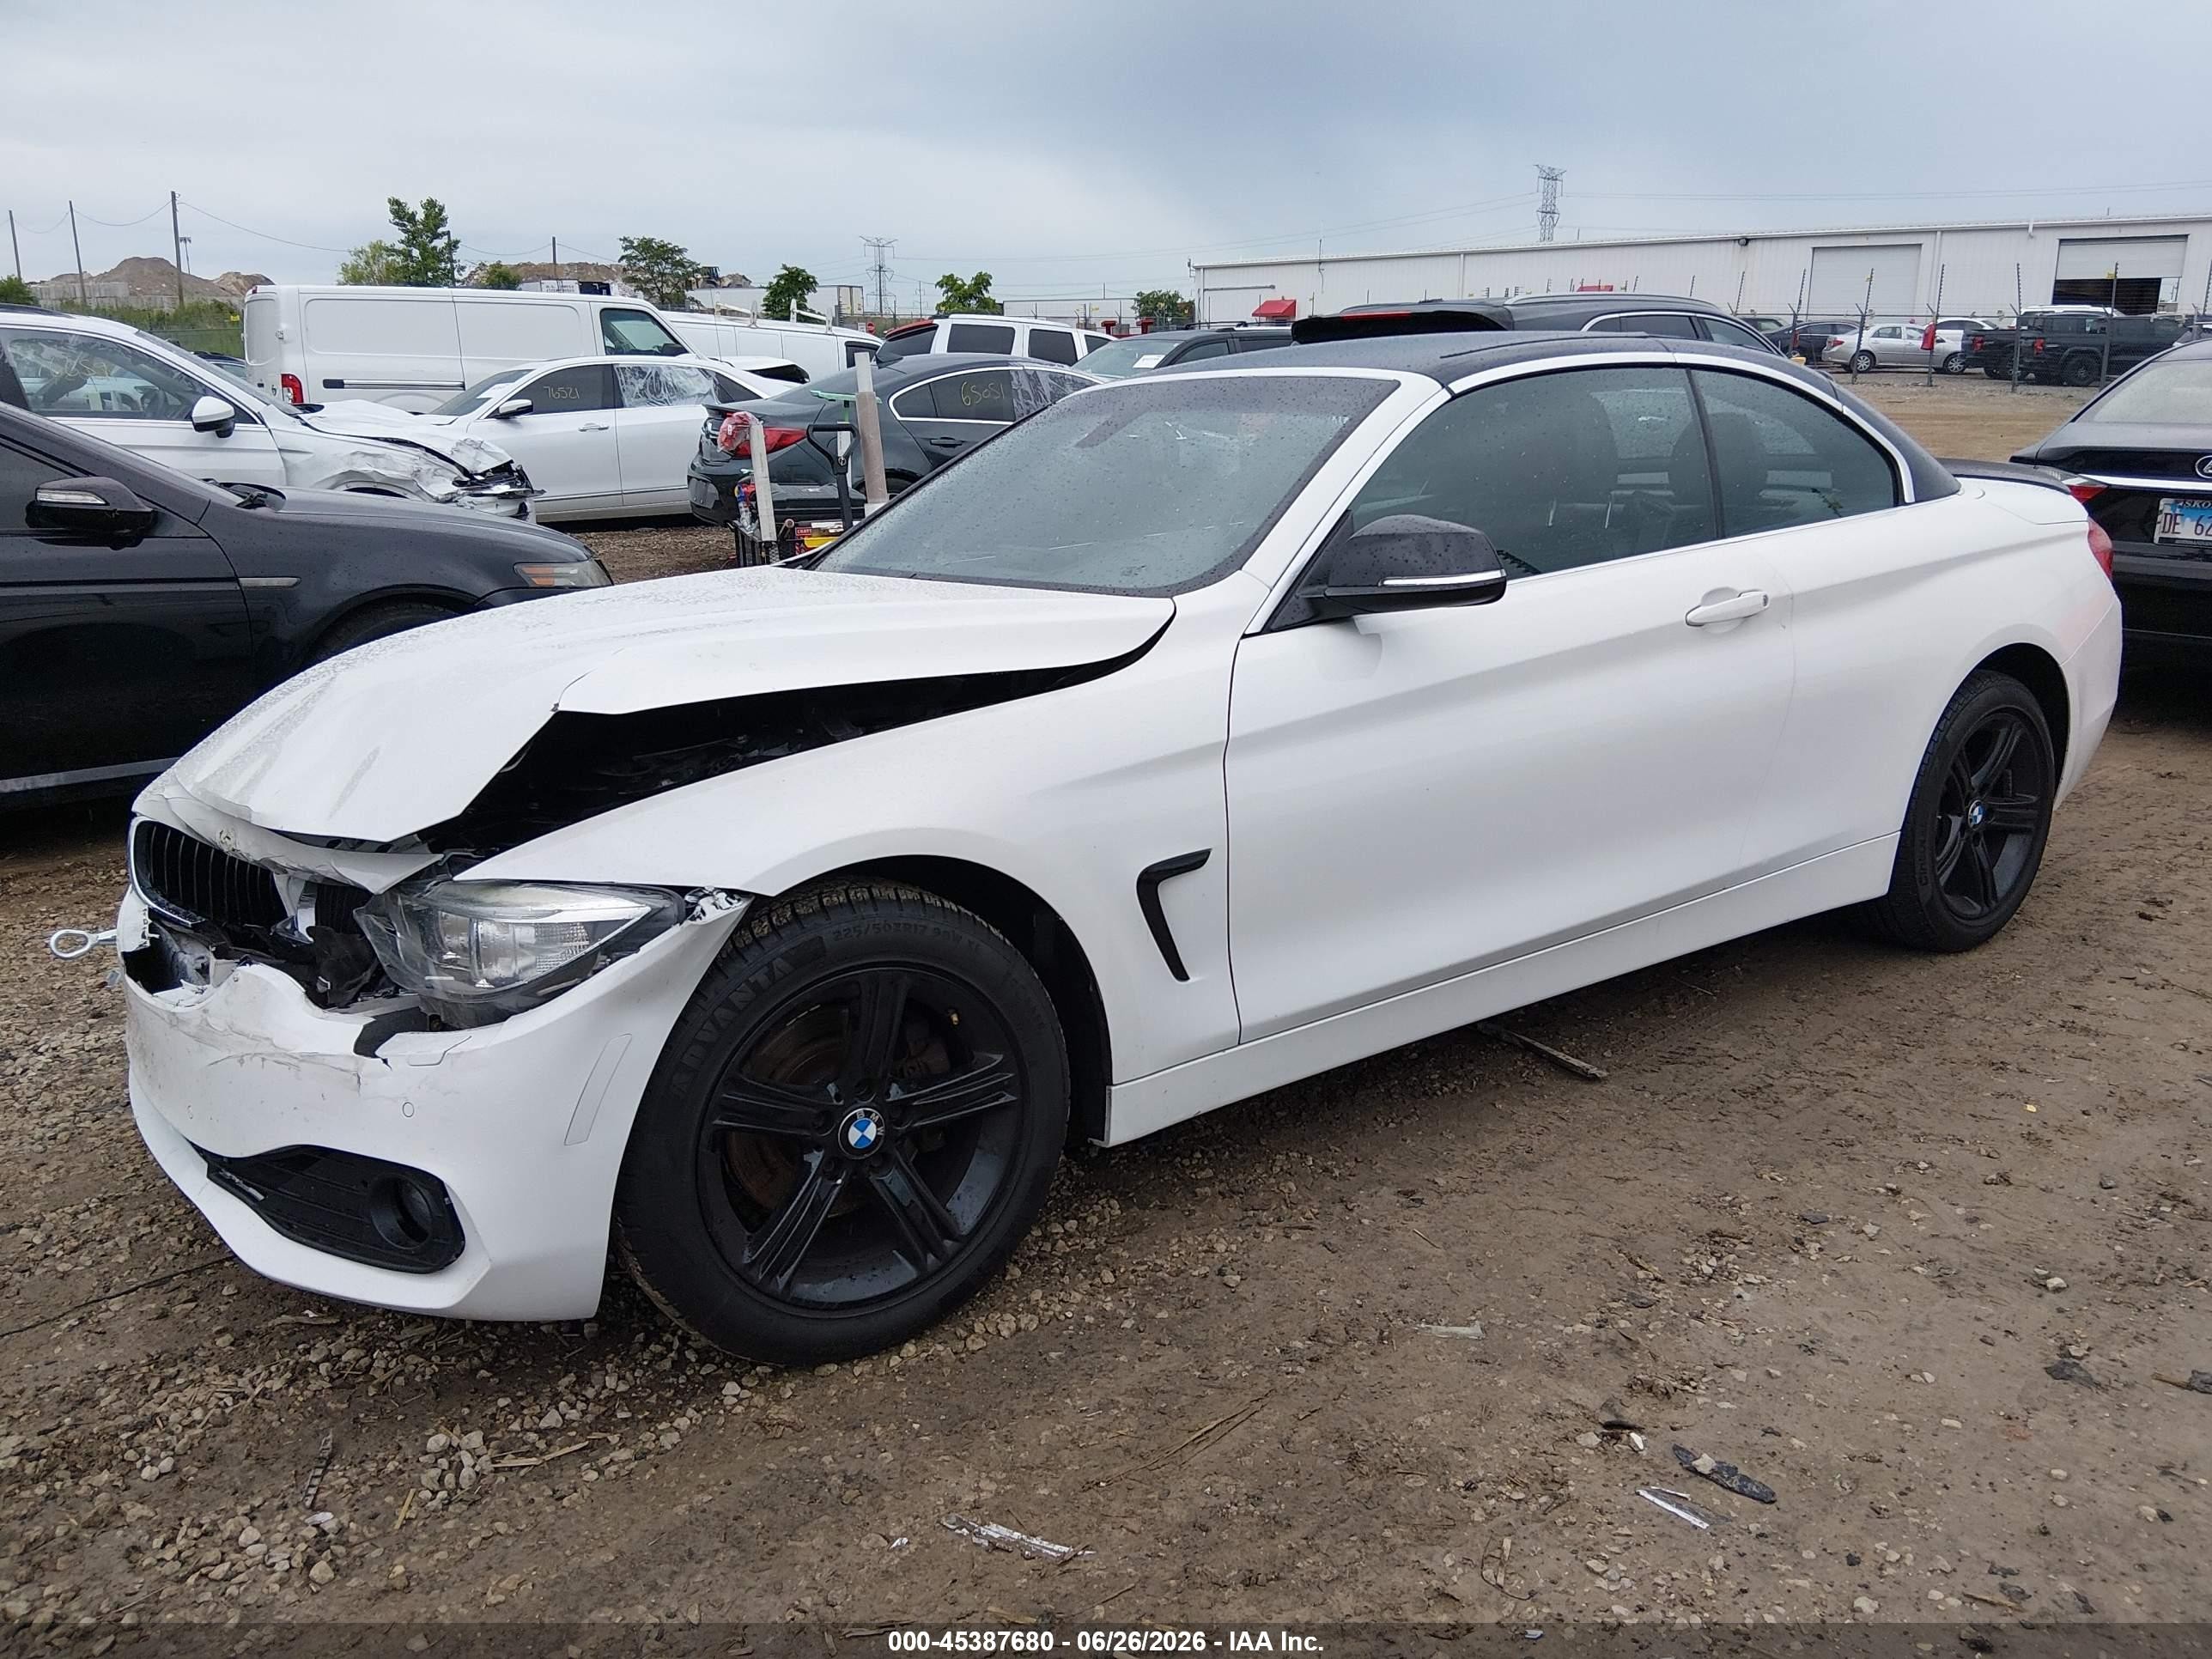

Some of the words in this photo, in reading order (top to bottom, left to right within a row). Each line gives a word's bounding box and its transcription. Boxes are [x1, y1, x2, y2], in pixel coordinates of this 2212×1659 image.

[543, 386, 580, 399] 76521
[2160, 513, 2185, 535] DE
[671, 956, 795, 1094] ADVANTA
[856, 1109, 885, 1135] BMW
